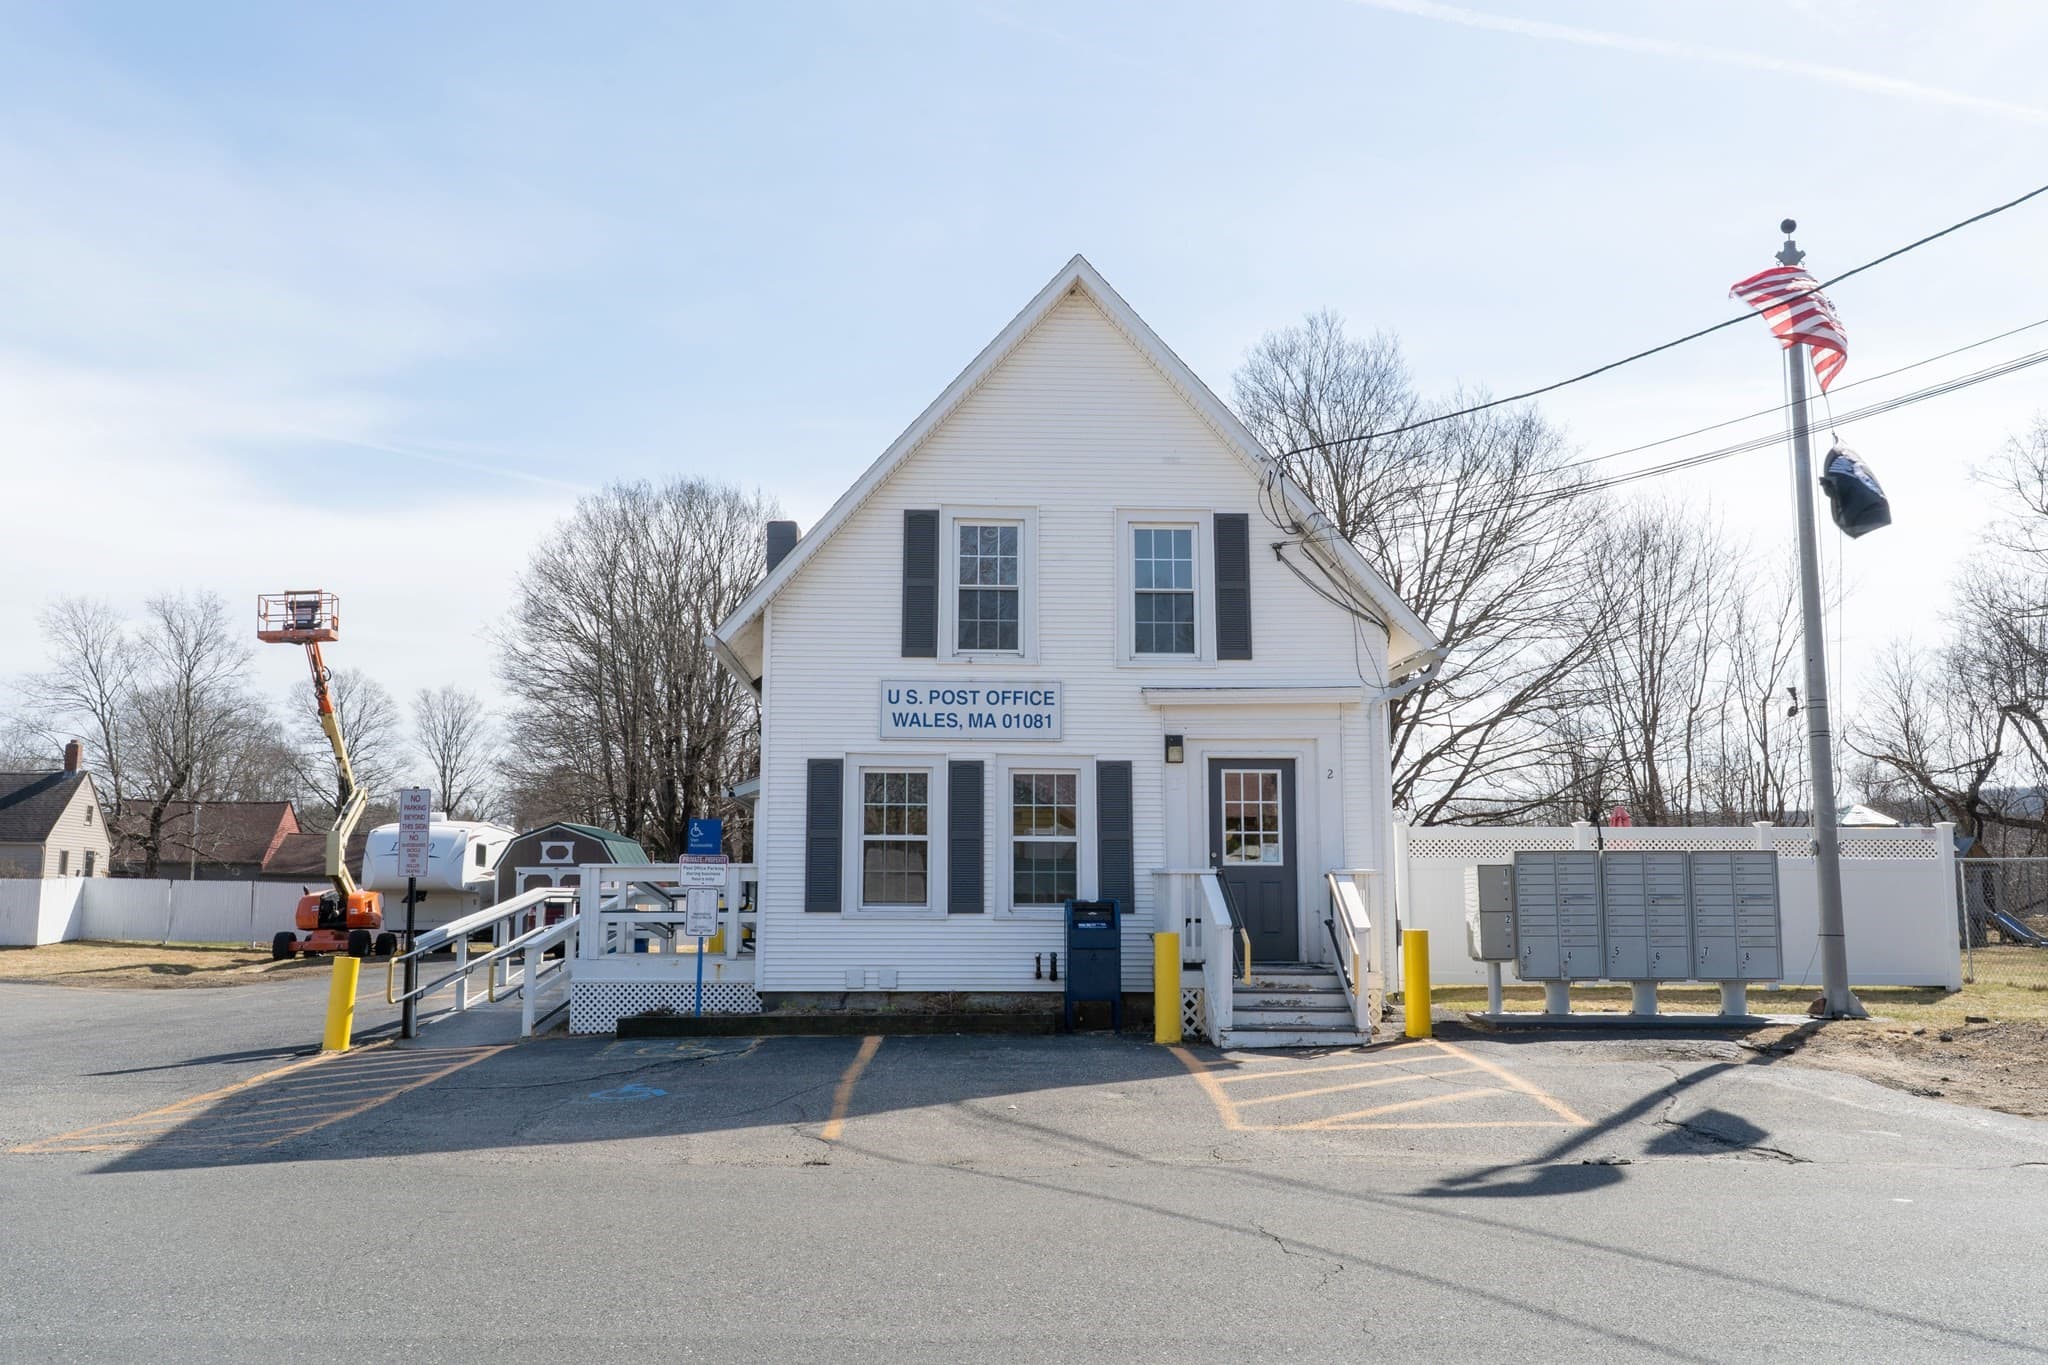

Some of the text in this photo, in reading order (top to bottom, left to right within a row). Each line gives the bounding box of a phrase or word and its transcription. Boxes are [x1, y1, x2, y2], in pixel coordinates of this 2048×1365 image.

[929, 689, 981, 706] POST
[986, 690, 1056, 706] OFFICE
[892, 712, 1052, 730] WALES, MA 01081
[1327, 768, 1334, 779] 2
[410, 794, 420, 802] NO
[1504, 868, 1508, 877] 1
[1506, 915, 1511, 924] 2
[1527, 946, 1532, 955] 3
[1567, 951, 1572, 960] 4
[1615, 946, 1620, 956] 5
[1704, 946, 1709, 956] 7
[1655, 951, 1661, 961] 6
[1745, 951, 1750, 961] 8
